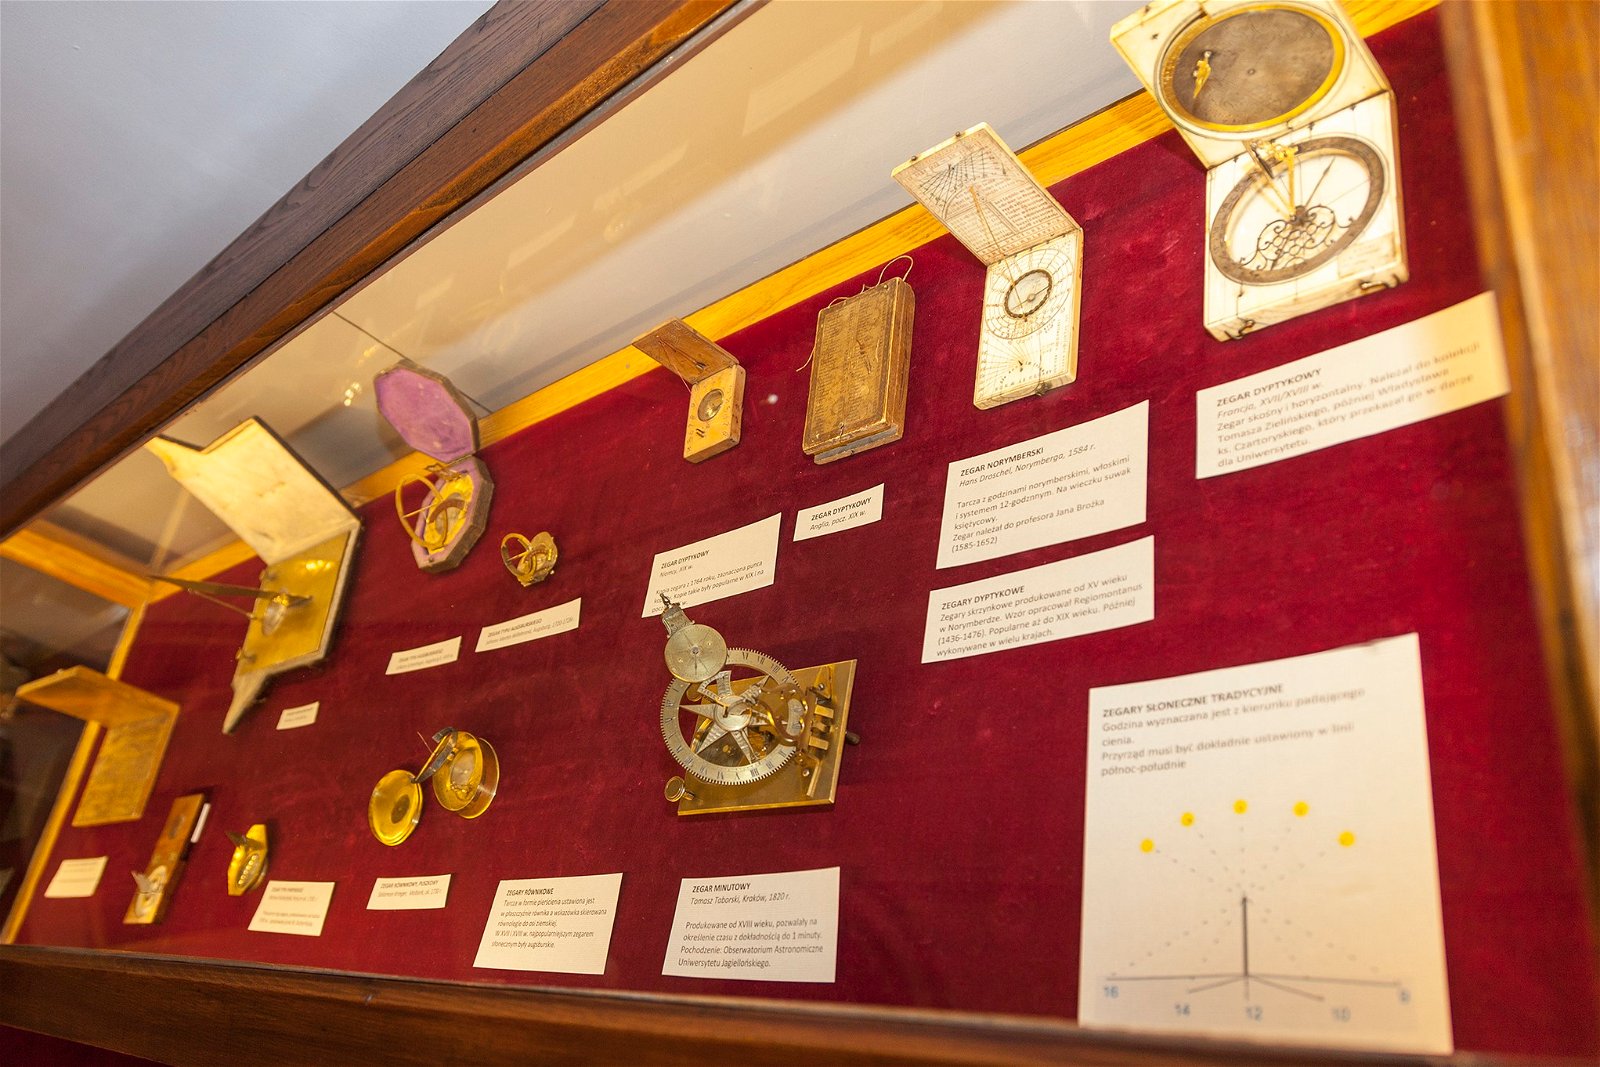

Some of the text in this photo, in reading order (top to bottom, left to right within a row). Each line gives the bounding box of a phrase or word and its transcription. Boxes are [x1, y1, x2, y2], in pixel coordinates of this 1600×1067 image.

[1216, 368, 1320, 407] ZEGAR DYPTYKOWY
[1217, 418, 1245, 431] Zegar
[1248, 407, 1283, 423] skośny
[1370, 364, 1412, 384] Należał
[1217, 368, 1449, 443] Tomasza Zielińskiego, później Władysława
[1217, 403, 1256, 418] Francja,
[1234, 424, 1312, 451] Czartoryskiego,
[1317, 414, 1346, 427] który
[1349, 395, 1404, 419] przekazał
[958, 477, 978, 487] Hans
[1014, 453, 1065, 472] Norymberga,
[1068, 444, 1088, 457] 1584
[960, 447, 1043, 477] ZEGAR NORYMBERSKI
[1217, 439, 1308, 468] dla Uniwersytetu.
[957, 498, 981, 508] Tarcza
[987, 484, 1027, 503] godzinami
[1028, 469, 1090, 491] norymberskimi,
[1092, 457, 1130, 472] włoskimi
[959, 504, 998, 519] systemem
[1056, 486, 1067, 494] Na
[1069, 477, 1102, 490] wieczku
[1104, 467, 1130, 481] suwak
[809, 520, 830, 531] Anglia,
[830, 516, 847, 526] pocz.
[847, 511, 858, 520] XIX
[811, 496, 872, 521] ZEGAR DYPTYKOWY
[952, 499, 1104, 541] Zegar należał do profesora Jana Brożka
[954, 517, 997, 530] księżycowy.
[951, 536, 998, 553] (1585-1652)
[660, 549, 710, 569] ZEGAR DYPTYKOWY
[940, 575, 1127, 622] Zegary skrzynkowe produkowane od XV wieku
[941, 585, 1024, 610] ZEGARY DYPTYKOWE
[947, 615, 1000, 631] Norymberdze.
[1004, 610, 1026, 620] Wzór
[1027, 598, 1072, 615] opracował
[1073, 583, 1143, 605] Regiomontanus
[988, 621, 1030, 635] Popularne
[1031, 618, 1041, 627] aż
[1042, 615, 1054, 624] do
[1056, 612, 1070, 622] XIX
[1103, 597, 1135, 612] Później
[936, 642, 987, 656] wykonywane
[998, 635, 1020, 645] wielu
[1022, 628, 1054, 640] krajach.
[1102, 684, 1284, 718] ZEGARY SŁONECZNE TRADYCYJNE
[1101, 721, 1144, 732] Godzina
[1146, 712, 1208, 727] wyznaczana
[1211, 707, 1231, 720] jest
[1241, 699, 1292, 713] kierunku
[1101, 737, 1134, 747] cienia.
[1101, 749, 1145, 761] Przyrząd
[1148, 747, 1174, 756] musi
[1175, 743, 1195, 754] być
[1196, 737, 1252, 751] dokładnie
[1100, 760, 1187, 777] północ-południe
[690, 897, 714, 905] Tomasz
[714, 895, 740, 904] Taborski,
[742, 894, 767, 903] Kraków,
[768, 891, 785, 901] 1820
[692, 882, 750, 893] ZEGAR MINUTOWY
[685, 921, 728, 929] Produkowane
[728, 920, 737, 929] od
[737, 920, 753, 928] XVIII
[753, 919, 775, 928] wieku,
[775, 917, 808, 928] pozwalały
[682, 933, 715, 942] określenie
[738, 931, 781, 942] dokładnością
[781, 931, 791, 940] do
[680, 945, 823, 954] Pochodzenie: Obserwatorium Astronomiczne
[677, 957, 771, 969] Uniwersytetu Jagiellońskiego.
[1246, 1006, 1263, 1020] 12
